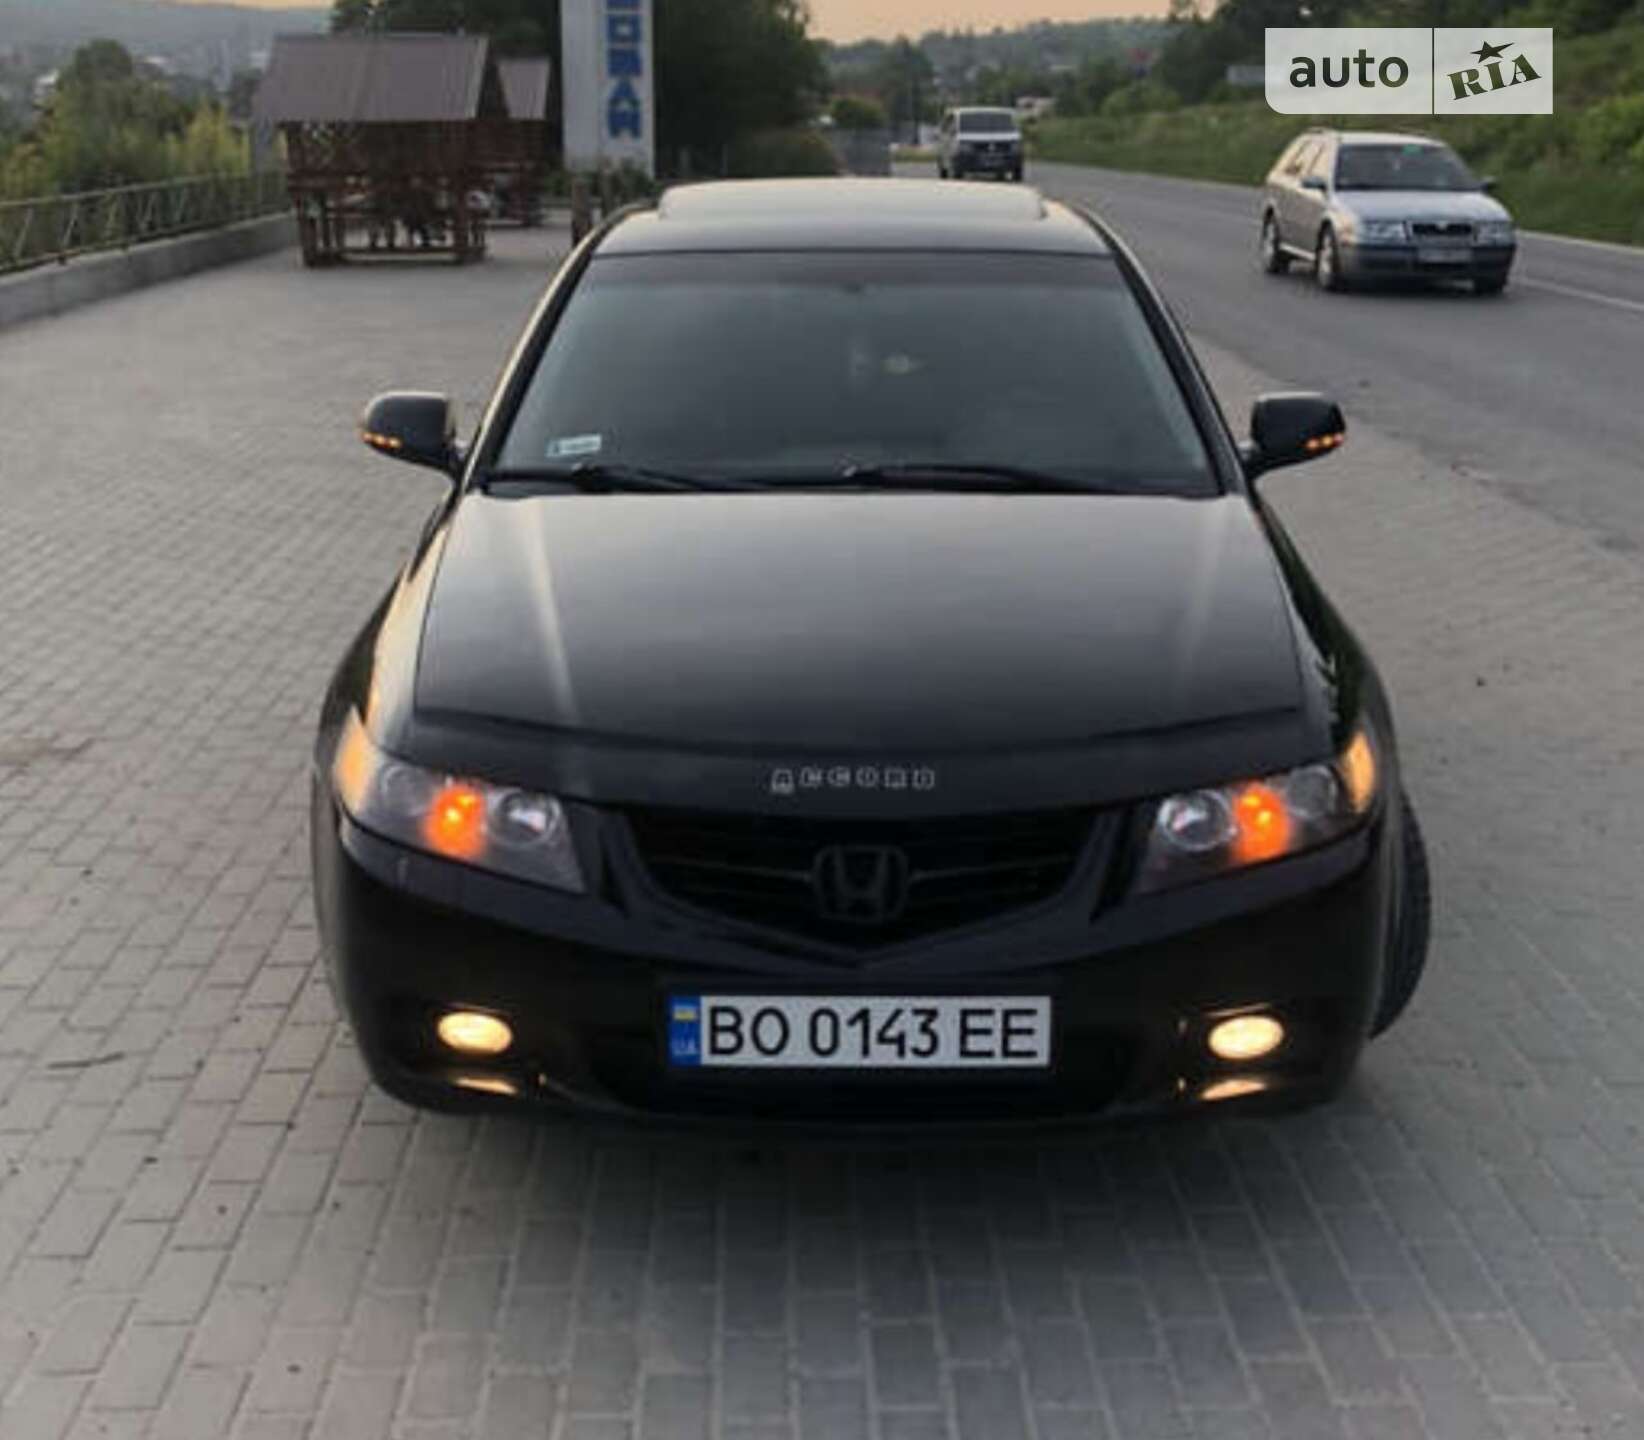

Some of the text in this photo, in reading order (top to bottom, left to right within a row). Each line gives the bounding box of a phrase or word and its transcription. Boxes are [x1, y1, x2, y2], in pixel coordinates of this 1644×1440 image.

[709, 1006, 1039, 1059] BO 0143 EE
